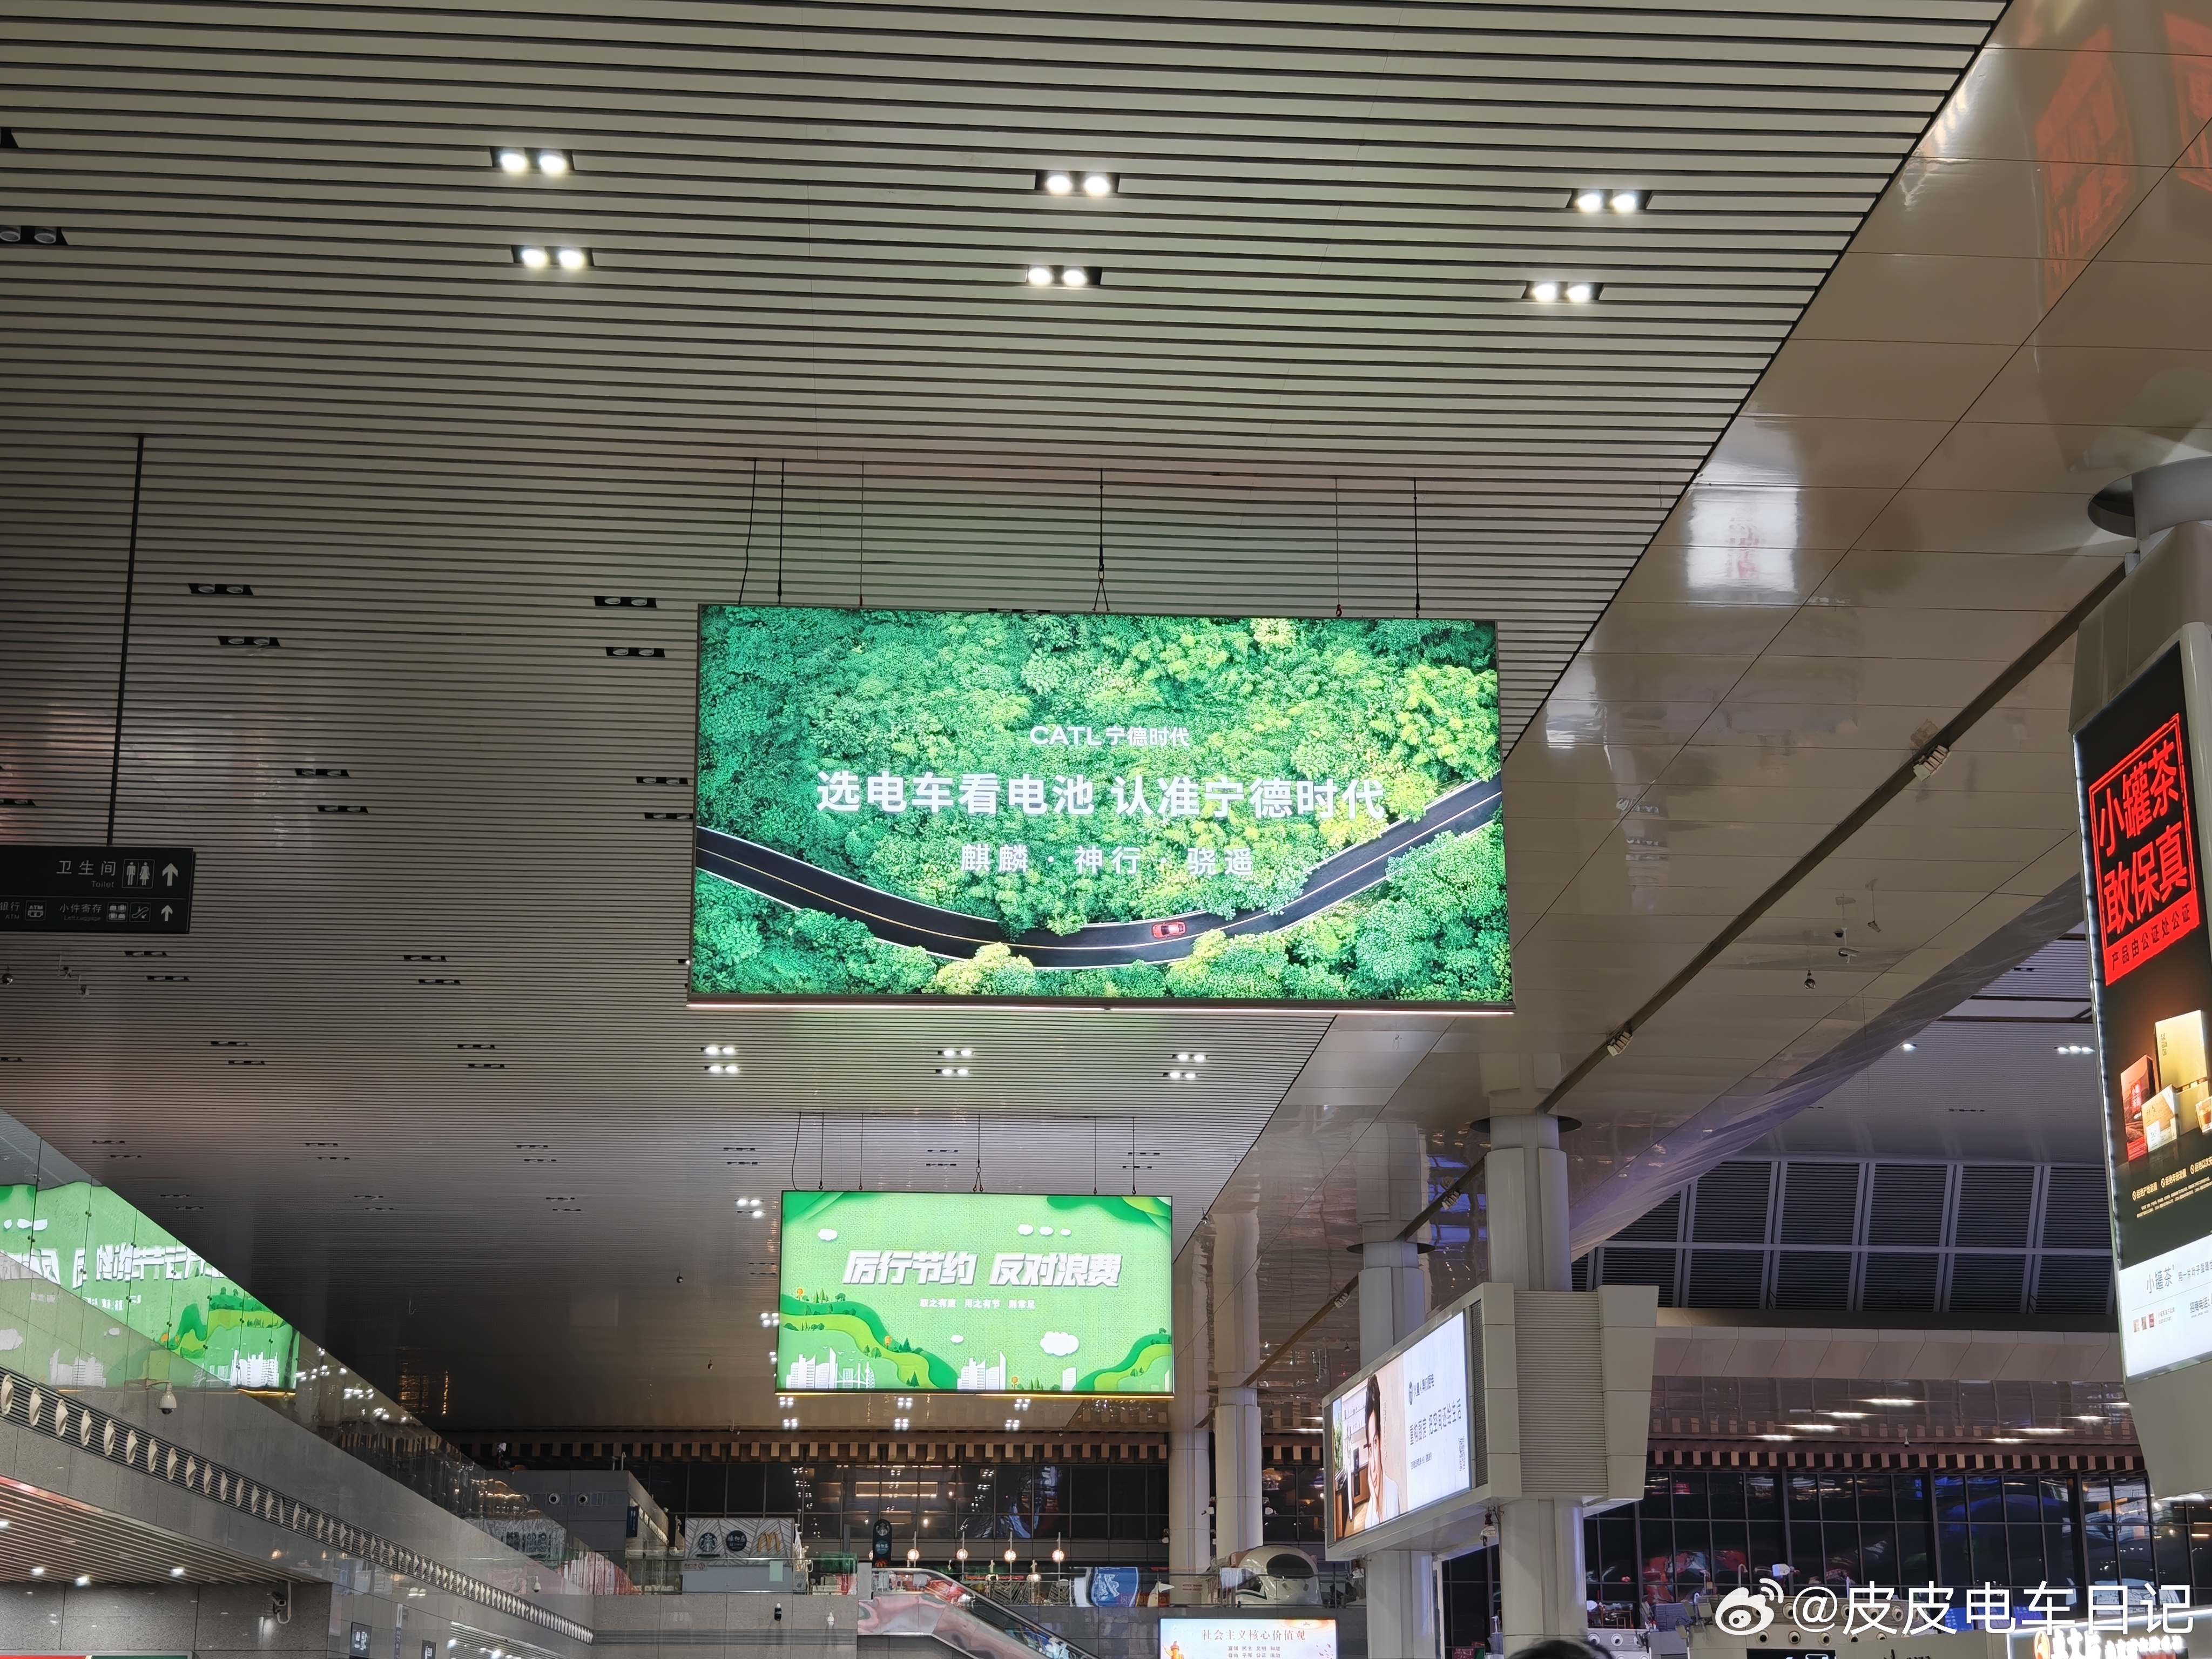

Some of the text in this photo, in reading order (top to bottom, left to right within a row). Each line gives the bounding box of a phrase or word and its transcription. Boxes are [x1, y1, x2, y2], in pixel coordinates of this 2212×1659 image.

[1030, 725, 1190, 747] CATL 宁德时代
[817, 770, 1385, 820] 选电车看电池 认准宁德时代
[2100, 740, 2179, 857] 小罐茶
[56, 860, 116, 876] 卫生间
[2104, 821, 2187, 934] 敢保真
[91, 880, 114, 888] Toilet
[59, 903, 103, 913] 小件寄存
[2112, 903, 2190, 970] 产品由公证处公证
[842, 1250, 1122, 1287] 厉行节约 反对浪费
[1203, 1629, 1305, 1641] 社会主义核心价值观
